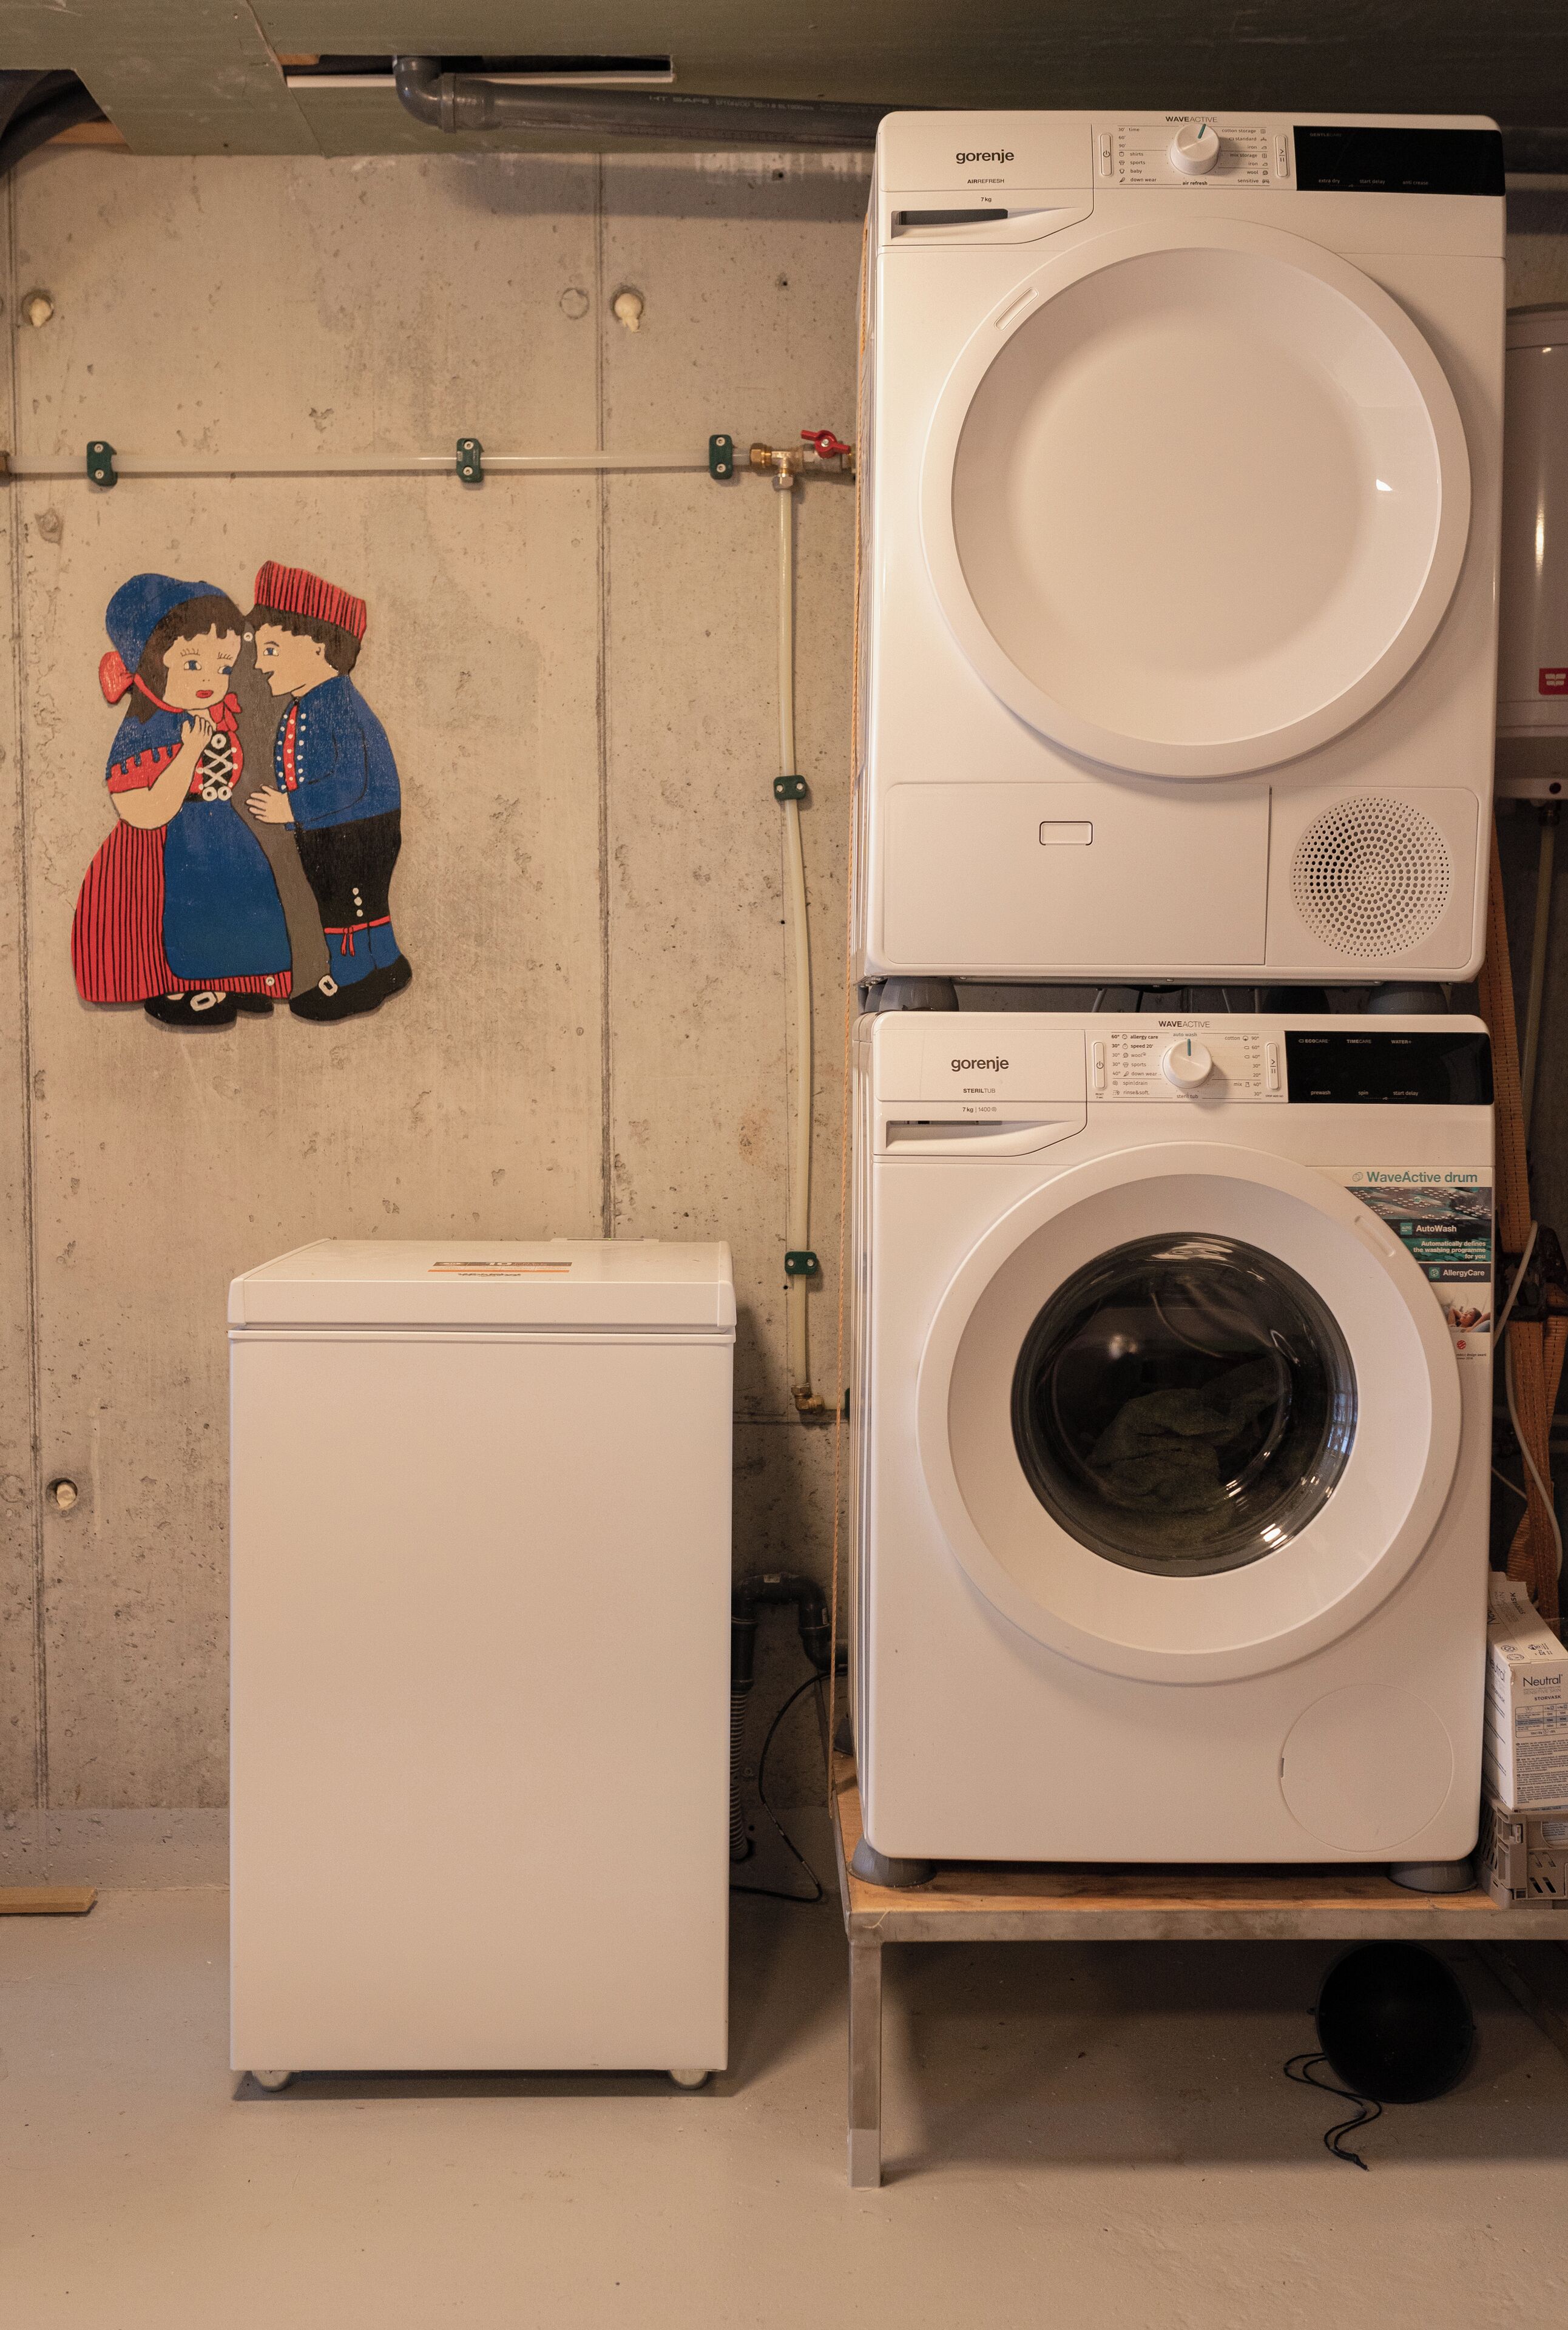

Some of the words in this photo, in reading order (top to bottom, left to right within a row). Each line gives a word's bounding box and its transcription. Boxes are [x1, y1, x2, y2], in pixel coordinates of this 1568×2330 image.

[956, 149, 1015, 164] gorenje
[951, 1056, 1009, 1072] gorenje
[1367, 1171, 1441, 1183] WaveActive
[1444, 1172, 1478, 1183] drum
[1523, 1673, 1561, 1687] Neutral
